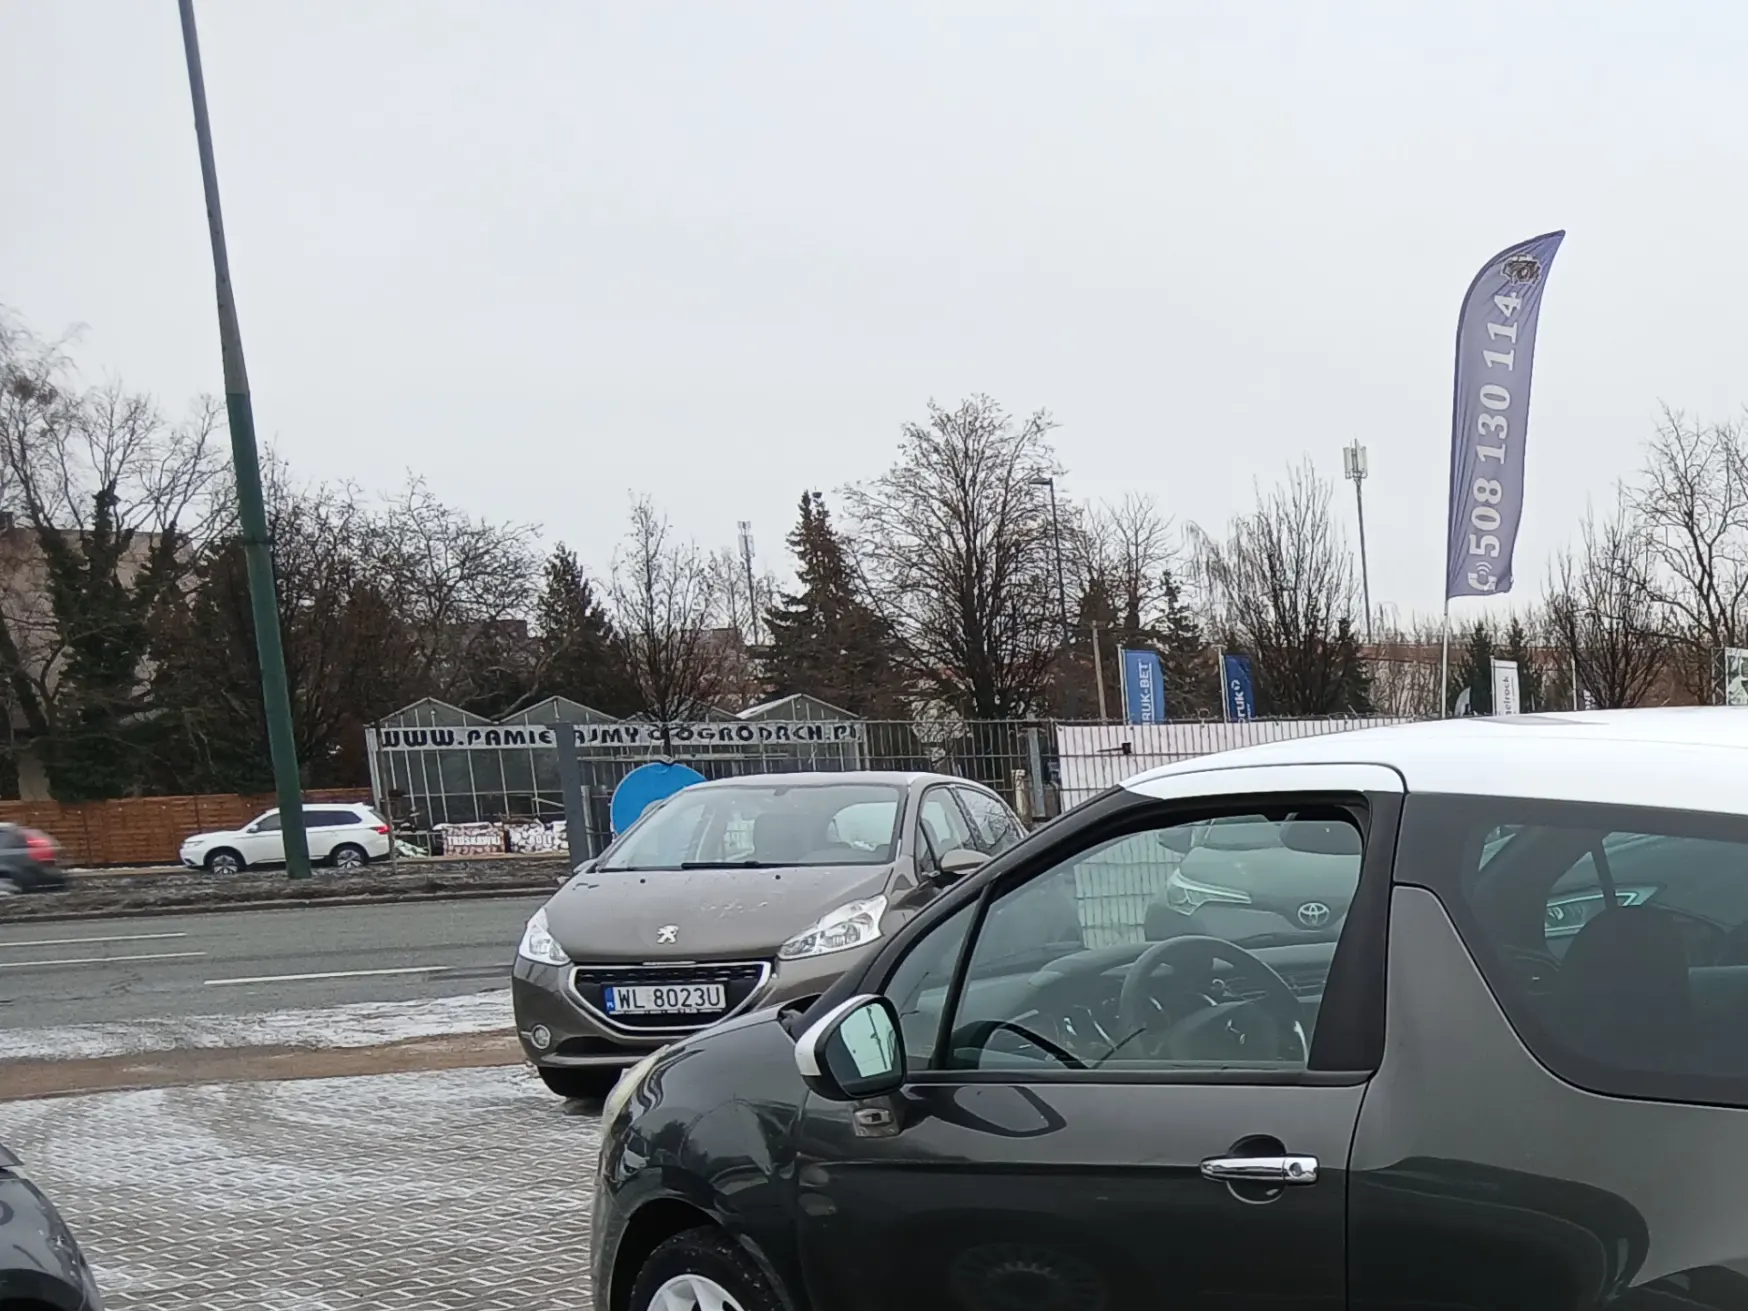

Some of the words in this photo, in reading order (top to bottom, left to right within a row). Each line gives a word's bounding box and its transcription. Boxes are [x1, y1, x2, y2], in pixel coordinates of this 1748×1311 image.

[1482, 292, 1522, 372] 114
[1475, 383, 1512, 465] 130
[1468, 477, 1503, 558] 508
[1137, 660, 1153, 726] RUK-BET
[618, 988, 646, 1009] WL
[653, 986, 721, 1008] 8023U
